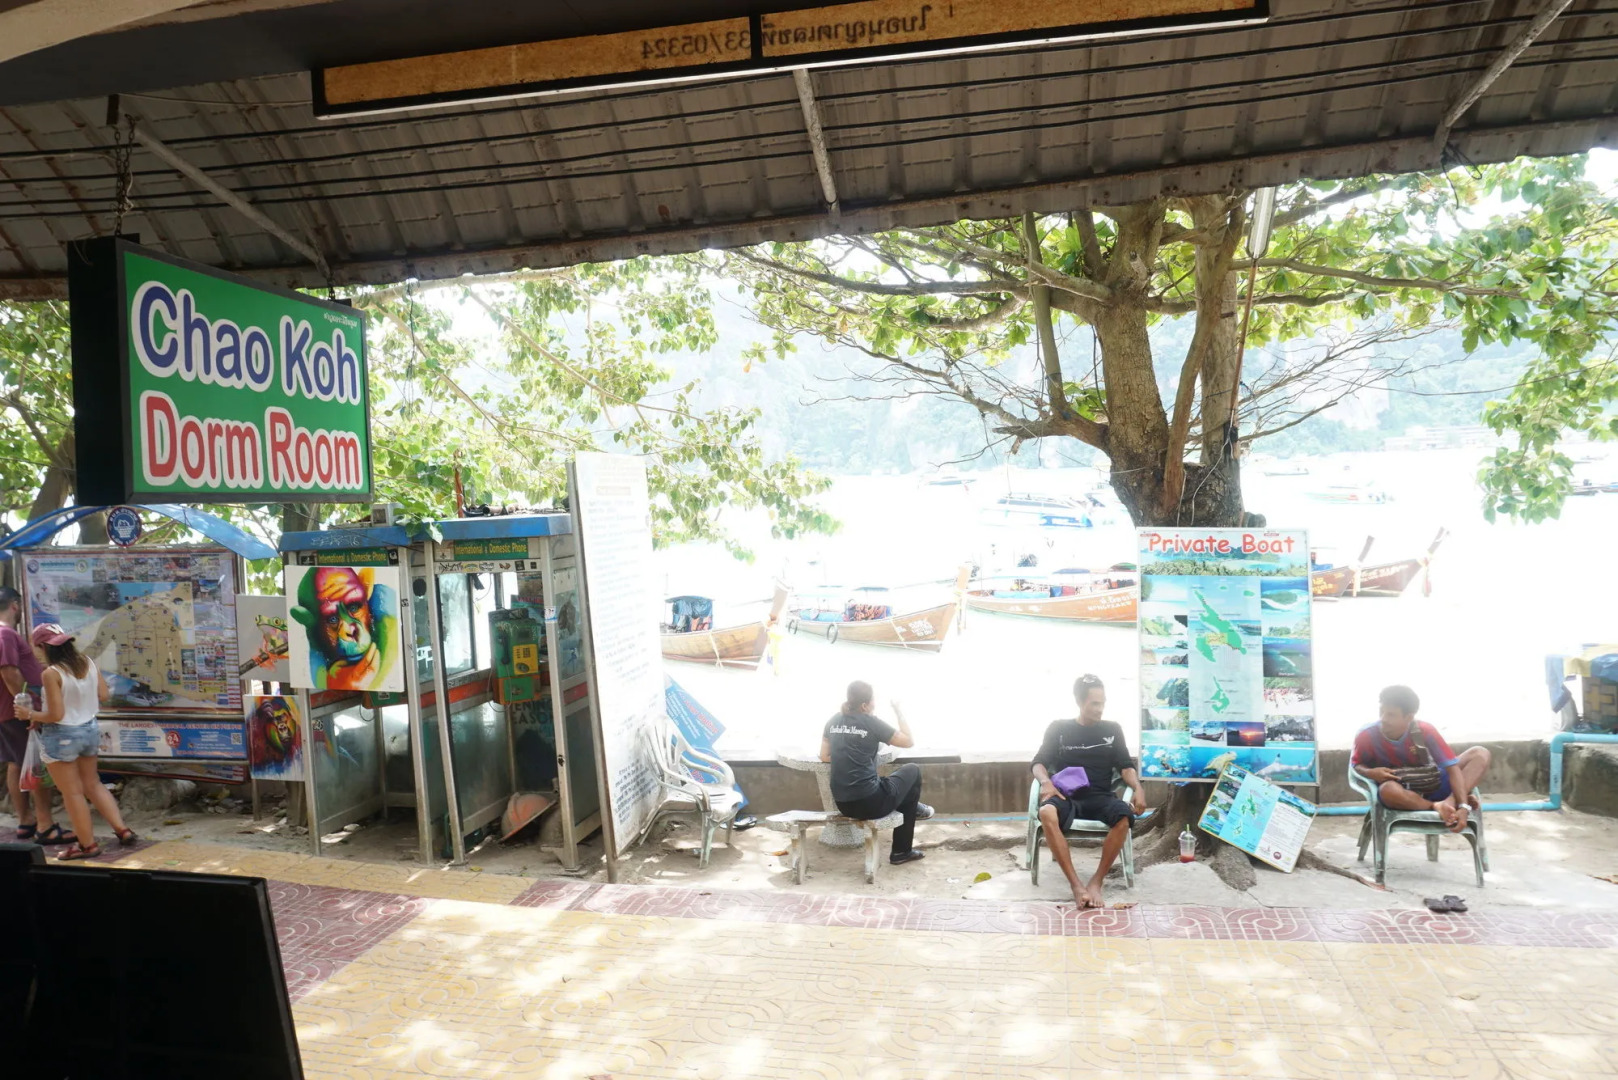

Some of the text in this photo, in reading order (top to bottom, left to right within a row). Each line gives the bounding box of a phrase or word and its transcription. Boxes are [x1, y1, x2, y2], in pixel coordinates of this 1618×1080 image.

[133, 282, 360, 404] Chao Koh
[141, 391, 362, 489] Dorm Room
[455, 543, 484, 555] International
[489, 543, 510, 553] Domestic
[512, 541, 527, 552] Phone
[1148, 533, 1296, 555] Private Boat
[351, 552, 371, 562] Domestic
[372, 551, 387, 561] Phone
